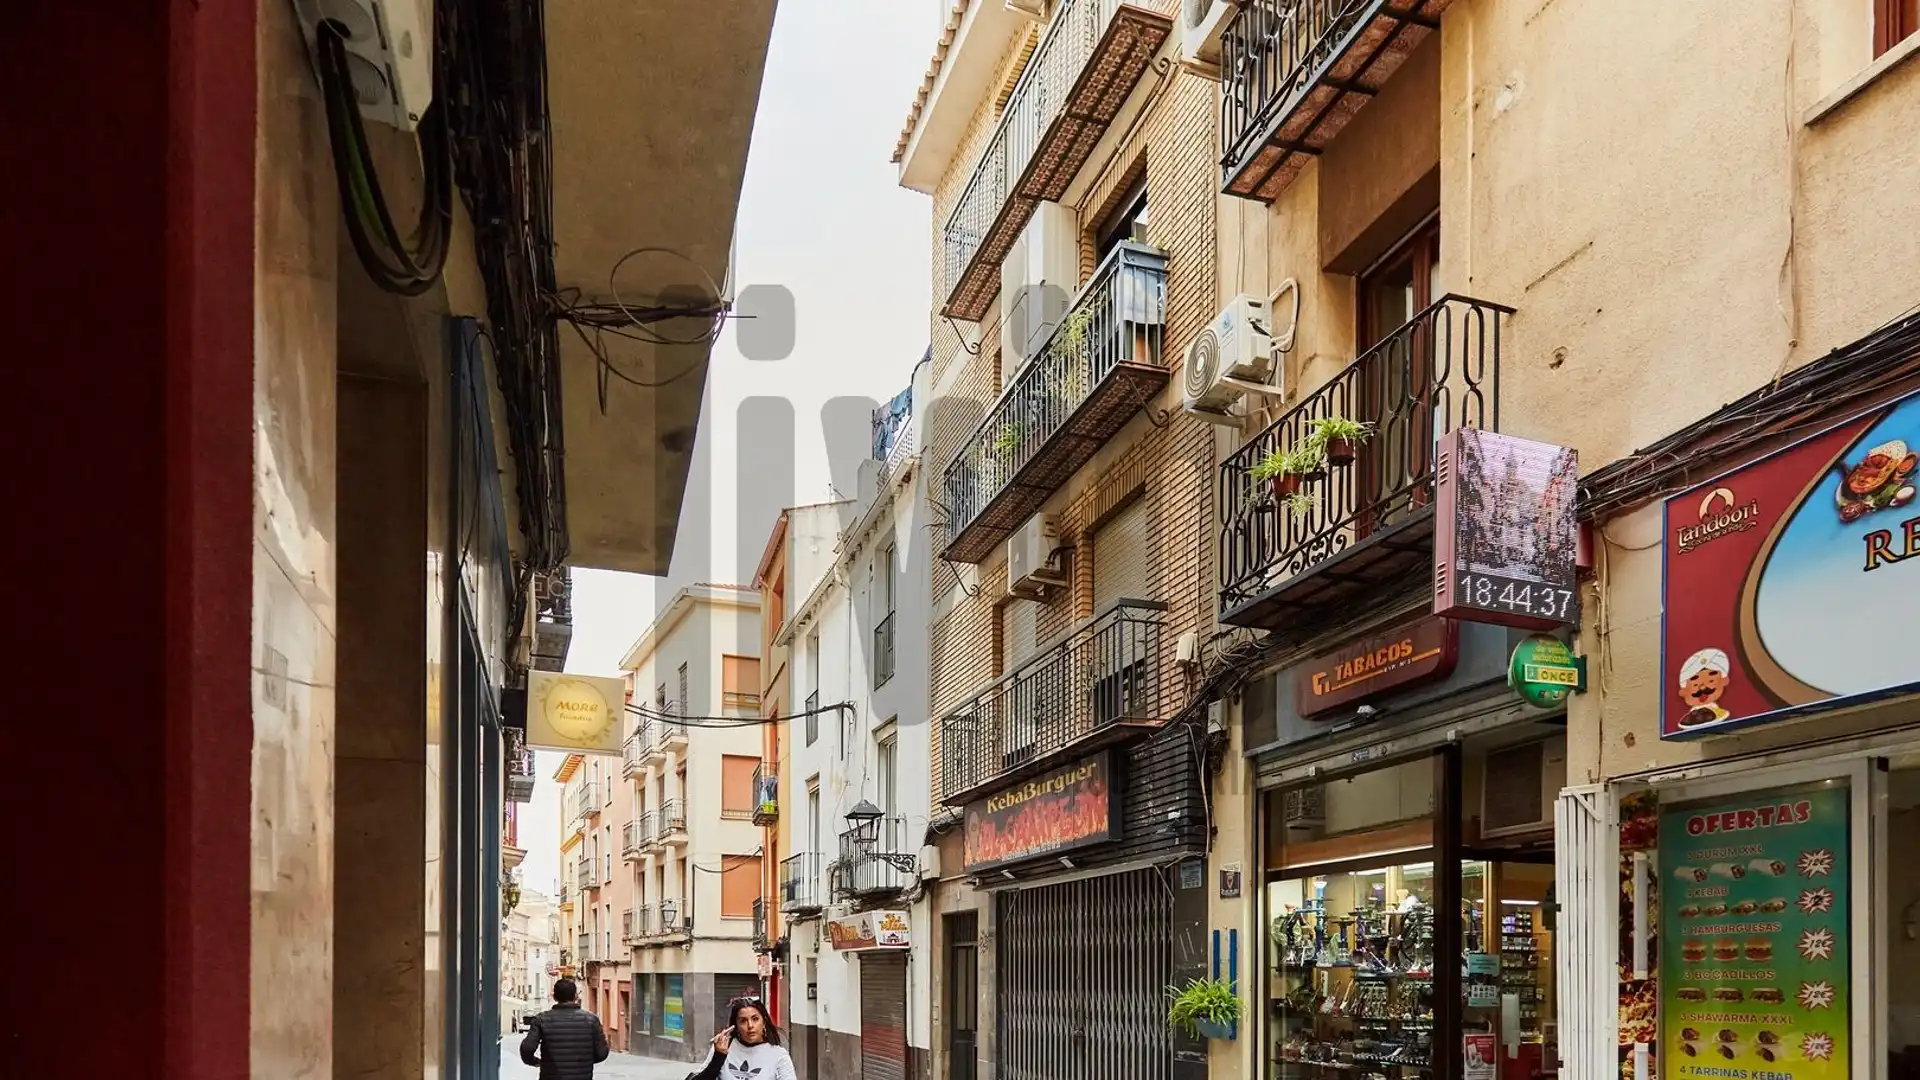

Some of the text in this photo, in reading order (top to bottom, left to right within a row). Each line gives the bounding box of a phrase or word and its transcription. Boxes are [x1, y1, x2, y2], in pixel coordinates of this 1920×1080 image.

[1861, 516, 1920, 572] RE
[1461, 575, 1572, 618] 18:44:37
[1334, 638, 1413, 681] TABACOS
[1541, 670, 1575, 683] ONCE
[986, 762, 1097, 814] KebaBurguer
[1687, 800, 1812, 837] OFERTAS
[1690, 922, 1782, 935] HAMBURGUESAS
[1694, 968, 1776, 980] BOCADILLOS
[1680, 1013, 1687, 1021] 3
[1689, 1012, 1758, 1024] SHAWARMA
[1679, 1066, 1687, 1074] 4
[1689, 1066, 1748, 1080] TARRINAS
